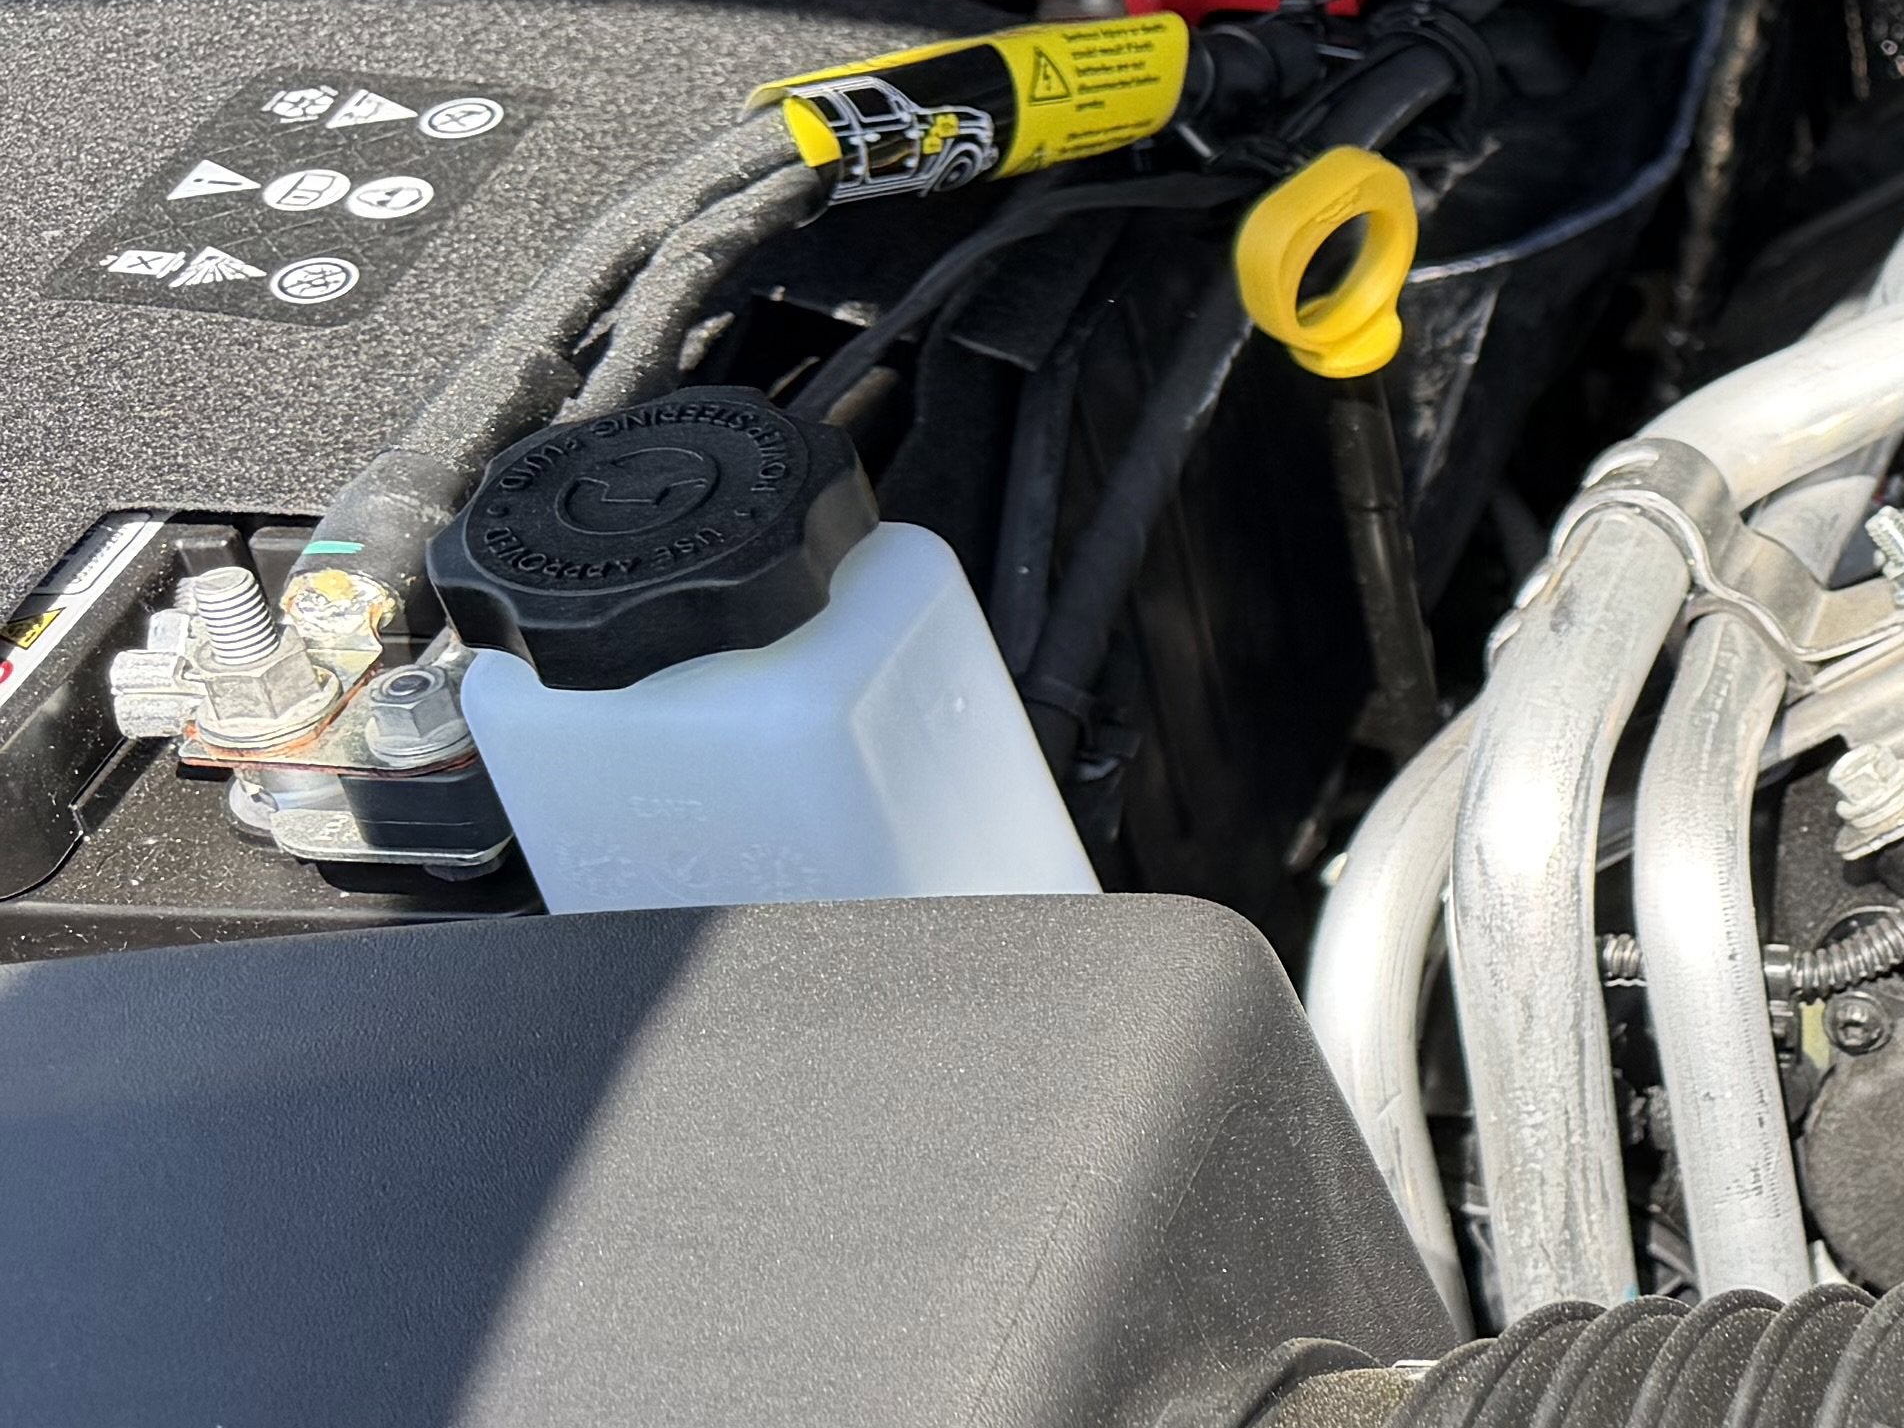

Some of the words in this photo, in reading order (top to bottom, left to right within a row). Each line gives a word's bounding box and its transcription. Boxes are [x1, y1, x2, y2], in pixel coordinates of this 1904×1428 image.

[591, 403, 756, 434] STEERING
[483, 526, 642, 580] APPROVED
[652, 527, 727, 564] USE
